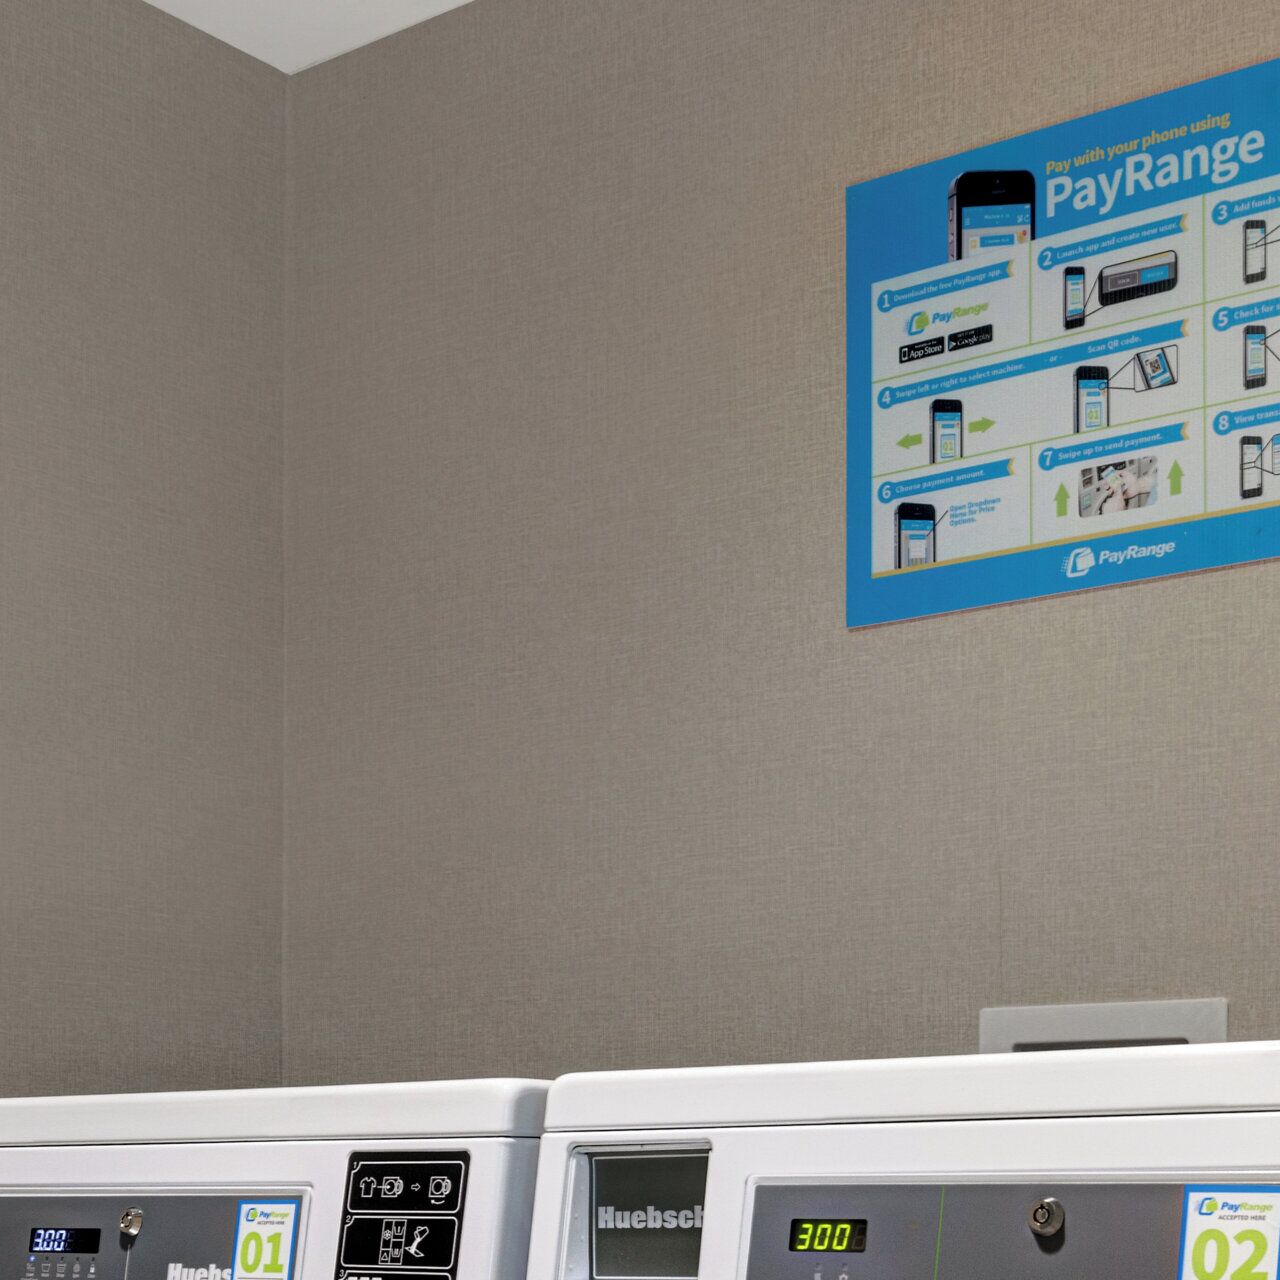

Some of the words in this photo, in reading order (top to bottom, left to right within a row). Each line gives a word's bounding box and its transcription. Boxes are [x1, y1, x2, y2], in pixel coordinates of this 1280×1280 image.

[1045, 161, 1071, 176] Pay
[1073, 146, 1105, 167] with
[1107, 138, 1140, 161] your
[1142, 125, 1188, 151] phone
[1190, 112, 1232, 134] using
[1045, 129, 1266, 219] PayRange
[1219, 205, 1229, 220] 3
[1233, 201, 1250, 213] Add
[1251, 196, 1276, 210] funds
[1042, 251, 1053, 266] 2
[1056, 245, 1084, 259] Launch
[1085, 243, 1100, 253] app
[1100, 236, 1115, 248] and
[1116, 232, 1141, 244] create
[1141, 228, 1158, 238] new
[882, 294, 891, 308] 1
[893, 286, 927, 302] Download
[927, 282, 938, 293] the
[932, 302, 989, 324] PayRange
[1218, 311, 1229, 327] 5
[1233, 307, 1260, 320] Check
[1261, 303, 1274, 314] for
[910, 345, 924, 358] App
[924, 343, 943, 356] Store
[957, 335, 978, 347] Google
[978, 333, 992, 344] play
[1087, 343, 1106, 354] Scan
[1107, 340, 1119, 351] QR
[882, 391, 892, 405] 4
[940, 377, 959, 389] right
[960, 376, 967, 384] to
[969, 369, 991, 382] select
[1218, 414, 1230, 430] 8
[1233, 413, 1255, 425] View
[1043, 450, 1053, 466] 7
[1058, 447, 1081, 461] Swipe
[1082, 446, 1094, 457] up
[1095, 445, 1103, 453] to
[1104, 439, 1124, 451] send
[882, 485, 891, 499] 6
[895, 482, 921, 493] Choose
[921, 476, 954, 489] payment
[1098, 541, 1176, 565] PayRange
[345, 1215, 351, 1223] 2
[1220, 1201, 1273, 1213] PayRange
[1250, 1214, 1267, 1222] HERE
[796, 1223, 851, 1250] 300
[239, 1231, 284, 1274] 01
[339, 1269, 345, 1277] 3
